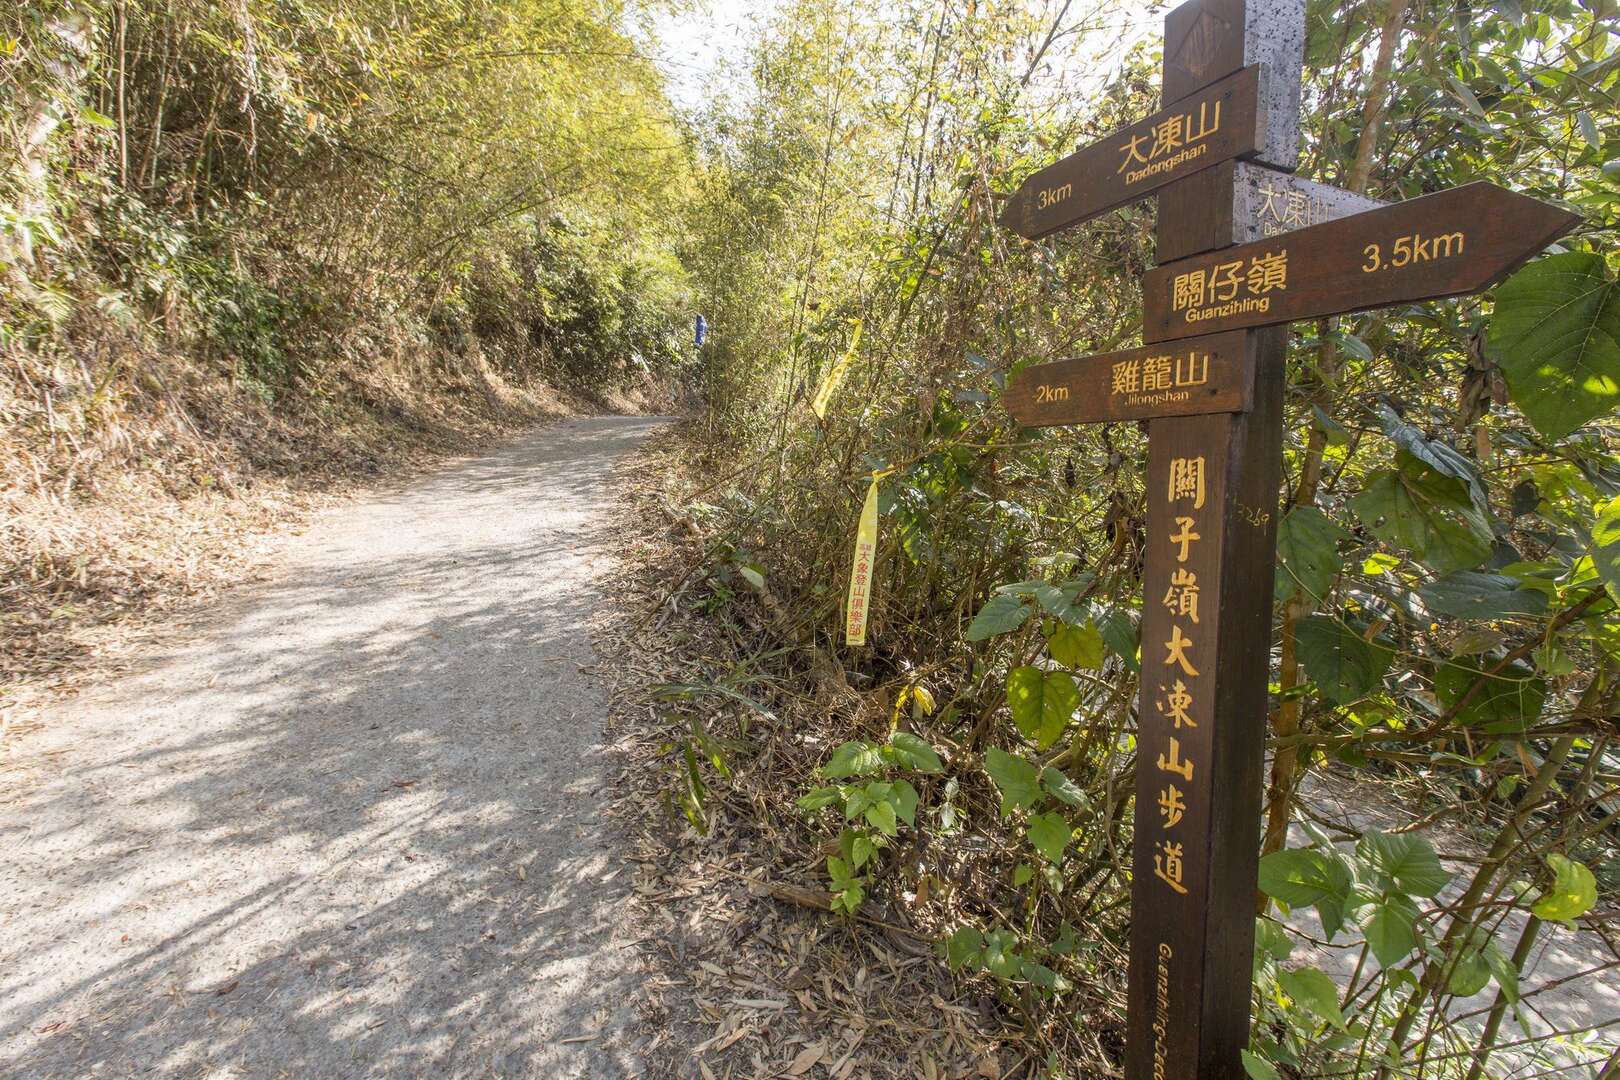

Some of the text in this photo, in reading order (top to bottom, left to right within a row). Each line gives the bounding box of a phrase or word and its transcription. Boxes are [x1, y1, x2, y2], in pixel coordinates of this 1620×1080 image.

[1116, 101, 1221, 174] 大凍山
[1125, 144, 1207, 185] Dadongshan
[1037, 182, 1073, 210] 3km
[1361, 231, 1465, 273] 3.5km
[1172, 249, 1289, 312] 關仔嶺
[1185, 295, 1270, 324] Guanzihling
[1035, 384, 1069, 403] 2km
[1111, 351, 1209, 395] 雞籠山
[1124, 389, 1190, 408] Jilongshan
